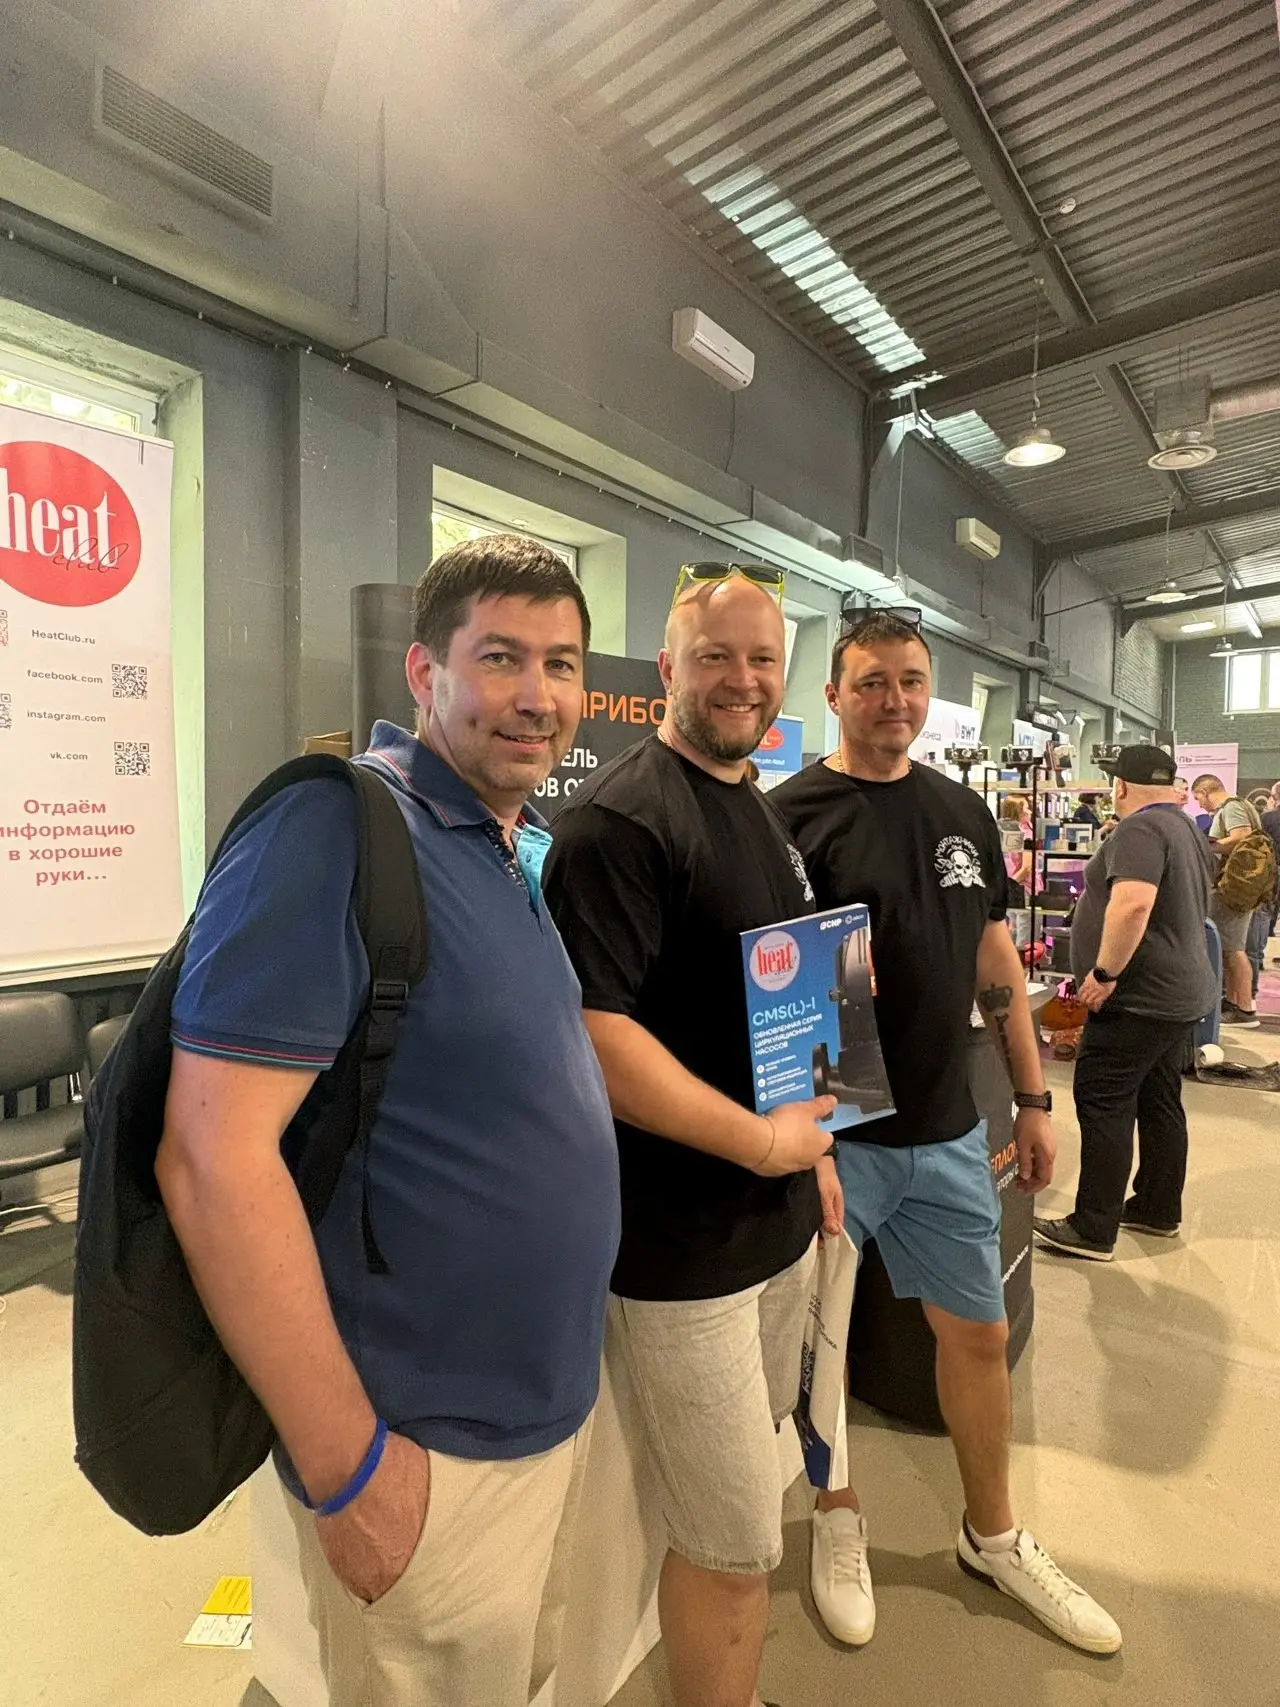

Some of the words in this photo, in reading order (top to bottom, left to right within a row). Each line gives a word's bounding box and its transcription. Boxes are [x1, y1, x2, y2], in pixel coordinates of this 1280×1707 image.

[0, 467, 119, 567] heat
[31, 629, 96, 645] HeatClub.ru
[27, 669, 103, 684] facebook.com
[27, 710, 106, 723] instagram.com
[50, 752, 88, 761] vk.com
[23, 799, 106, 816] Отдаём
[8, 850, 20, 861] в
[29, 846, 123, 862] хорошие
[36, 870, 107, 886] руки...
[756, 940, 794, 976] heat
